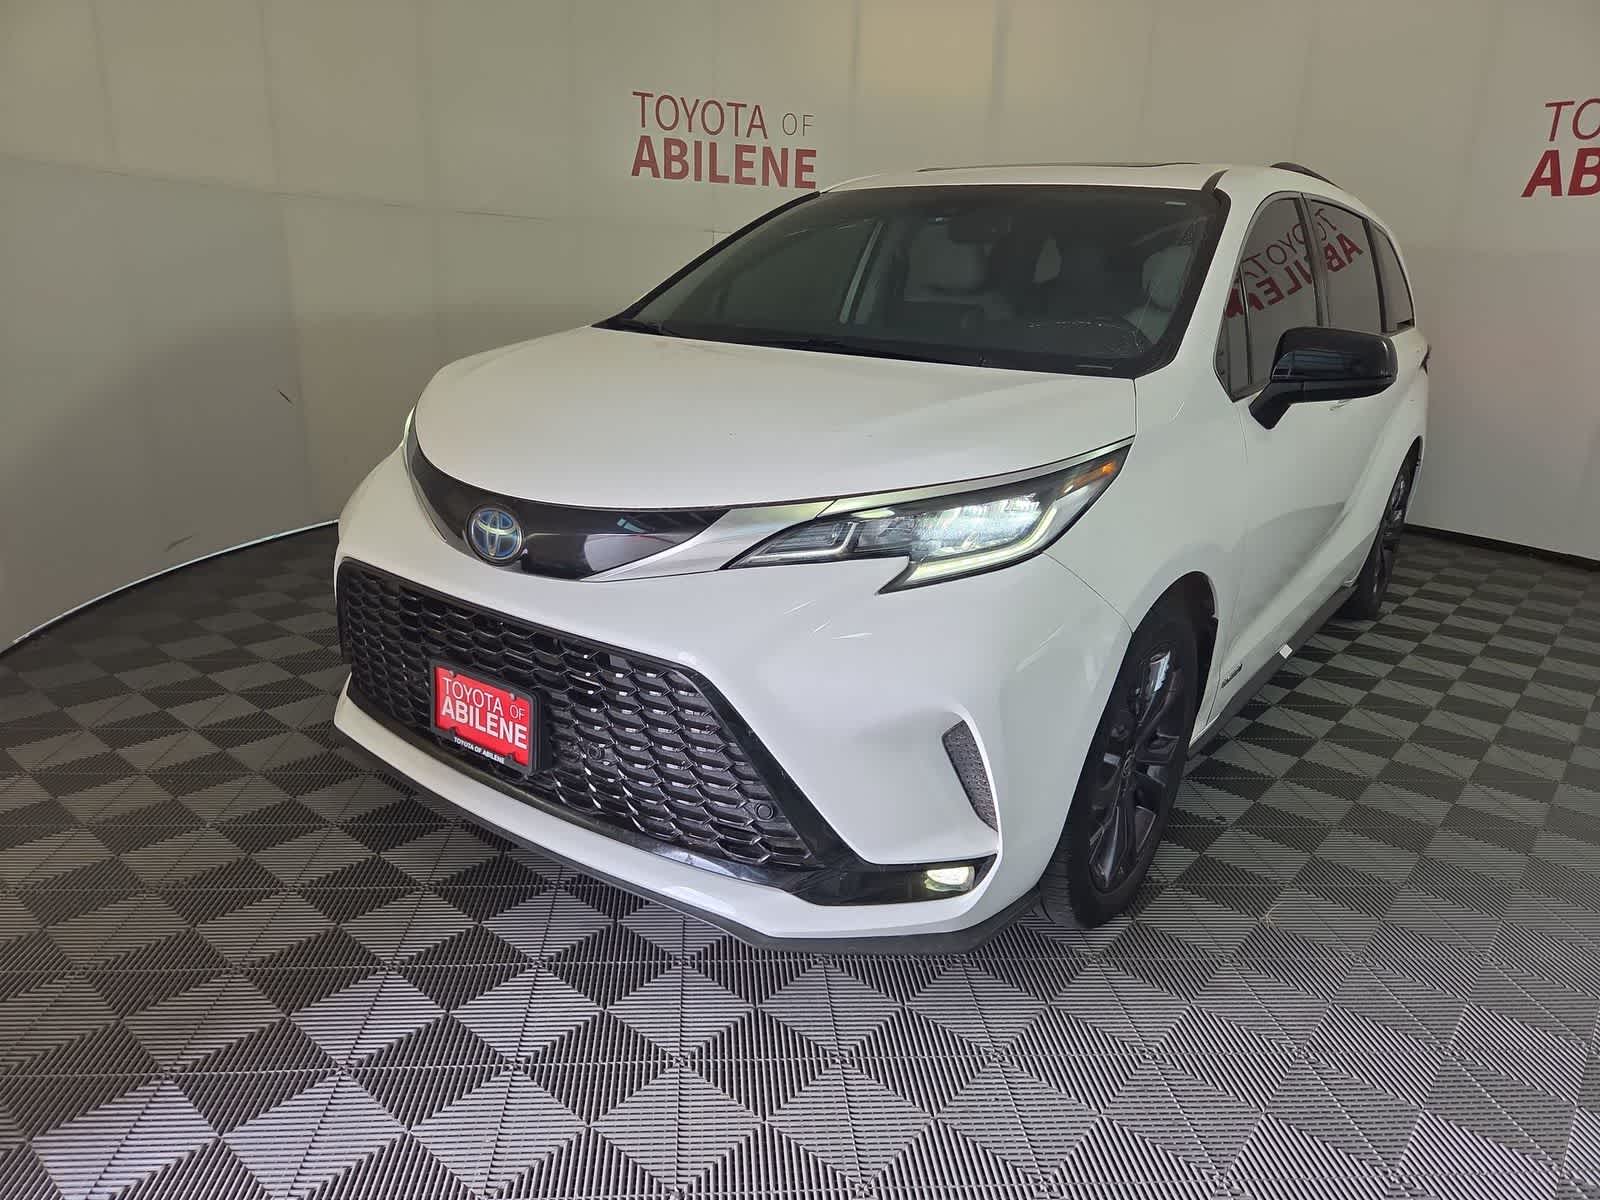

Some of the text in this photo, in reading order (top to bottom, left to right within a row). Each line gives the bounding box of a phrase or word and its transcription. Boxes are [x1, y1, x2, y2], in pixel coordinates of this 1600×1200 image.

[632, 91, 814, 140] TOYOTA OF
[631, 135, 817, 189] ABILENE
[441, 696, 528, 749] ABILENE
[442, 677, 525, 720] TOYOTA OF
[454, 737, 474, 750] TOYOTA
[482, 750, 505, 764] ABILENE
